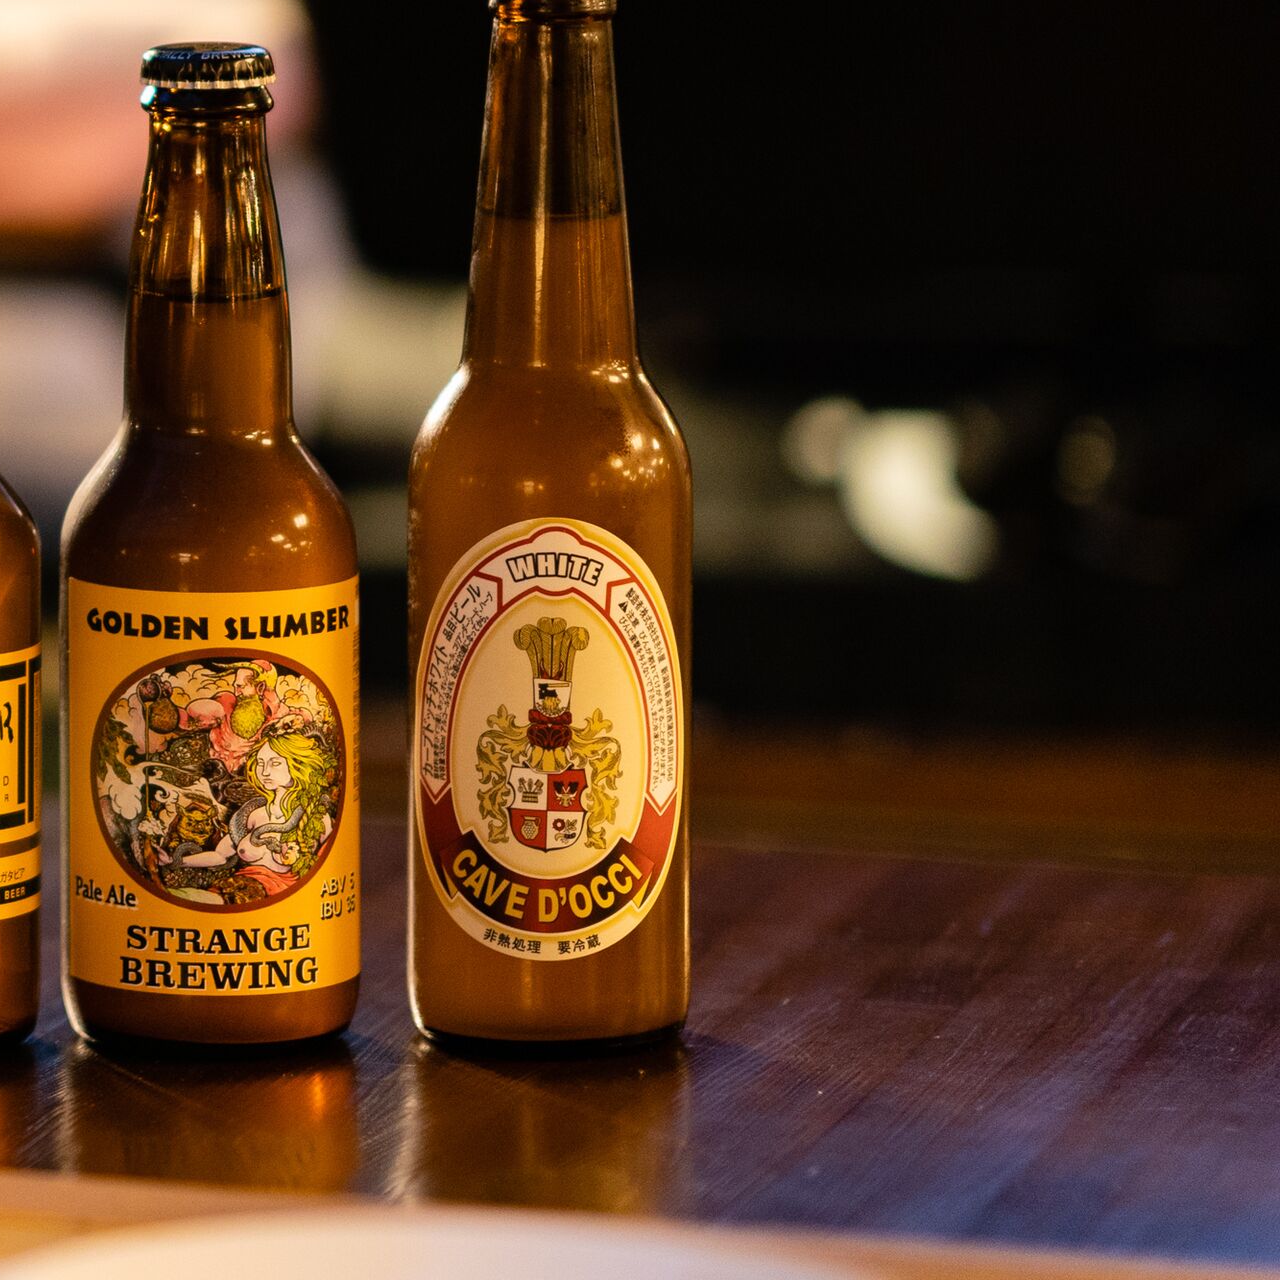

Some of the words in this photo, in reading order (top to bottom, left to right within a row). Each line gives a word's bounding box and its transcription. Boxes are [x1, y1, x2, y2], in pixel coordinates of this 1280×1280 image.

[506, 552, 604, 586] WHITE
[87, 607, 208, 640] GOLDEN
[224, 605, 349, 641] SLUMBER
[4, 886, 26, 900] BEER
[75, 876, 103, 903] Pale
[106, 885, 137, 908] Ale
[452, 848, 530, 920] CAVE
[538, 853, 643, 923] D'OCCI
[320, 899, 343, 920] IBU
[127, 924, 311, 954] STRANGE
[483, 927, 542, 954] 非熱処理
[558, 934, 602, 955] 要冷蔵
[120, 956, 319, 990] BREWING
